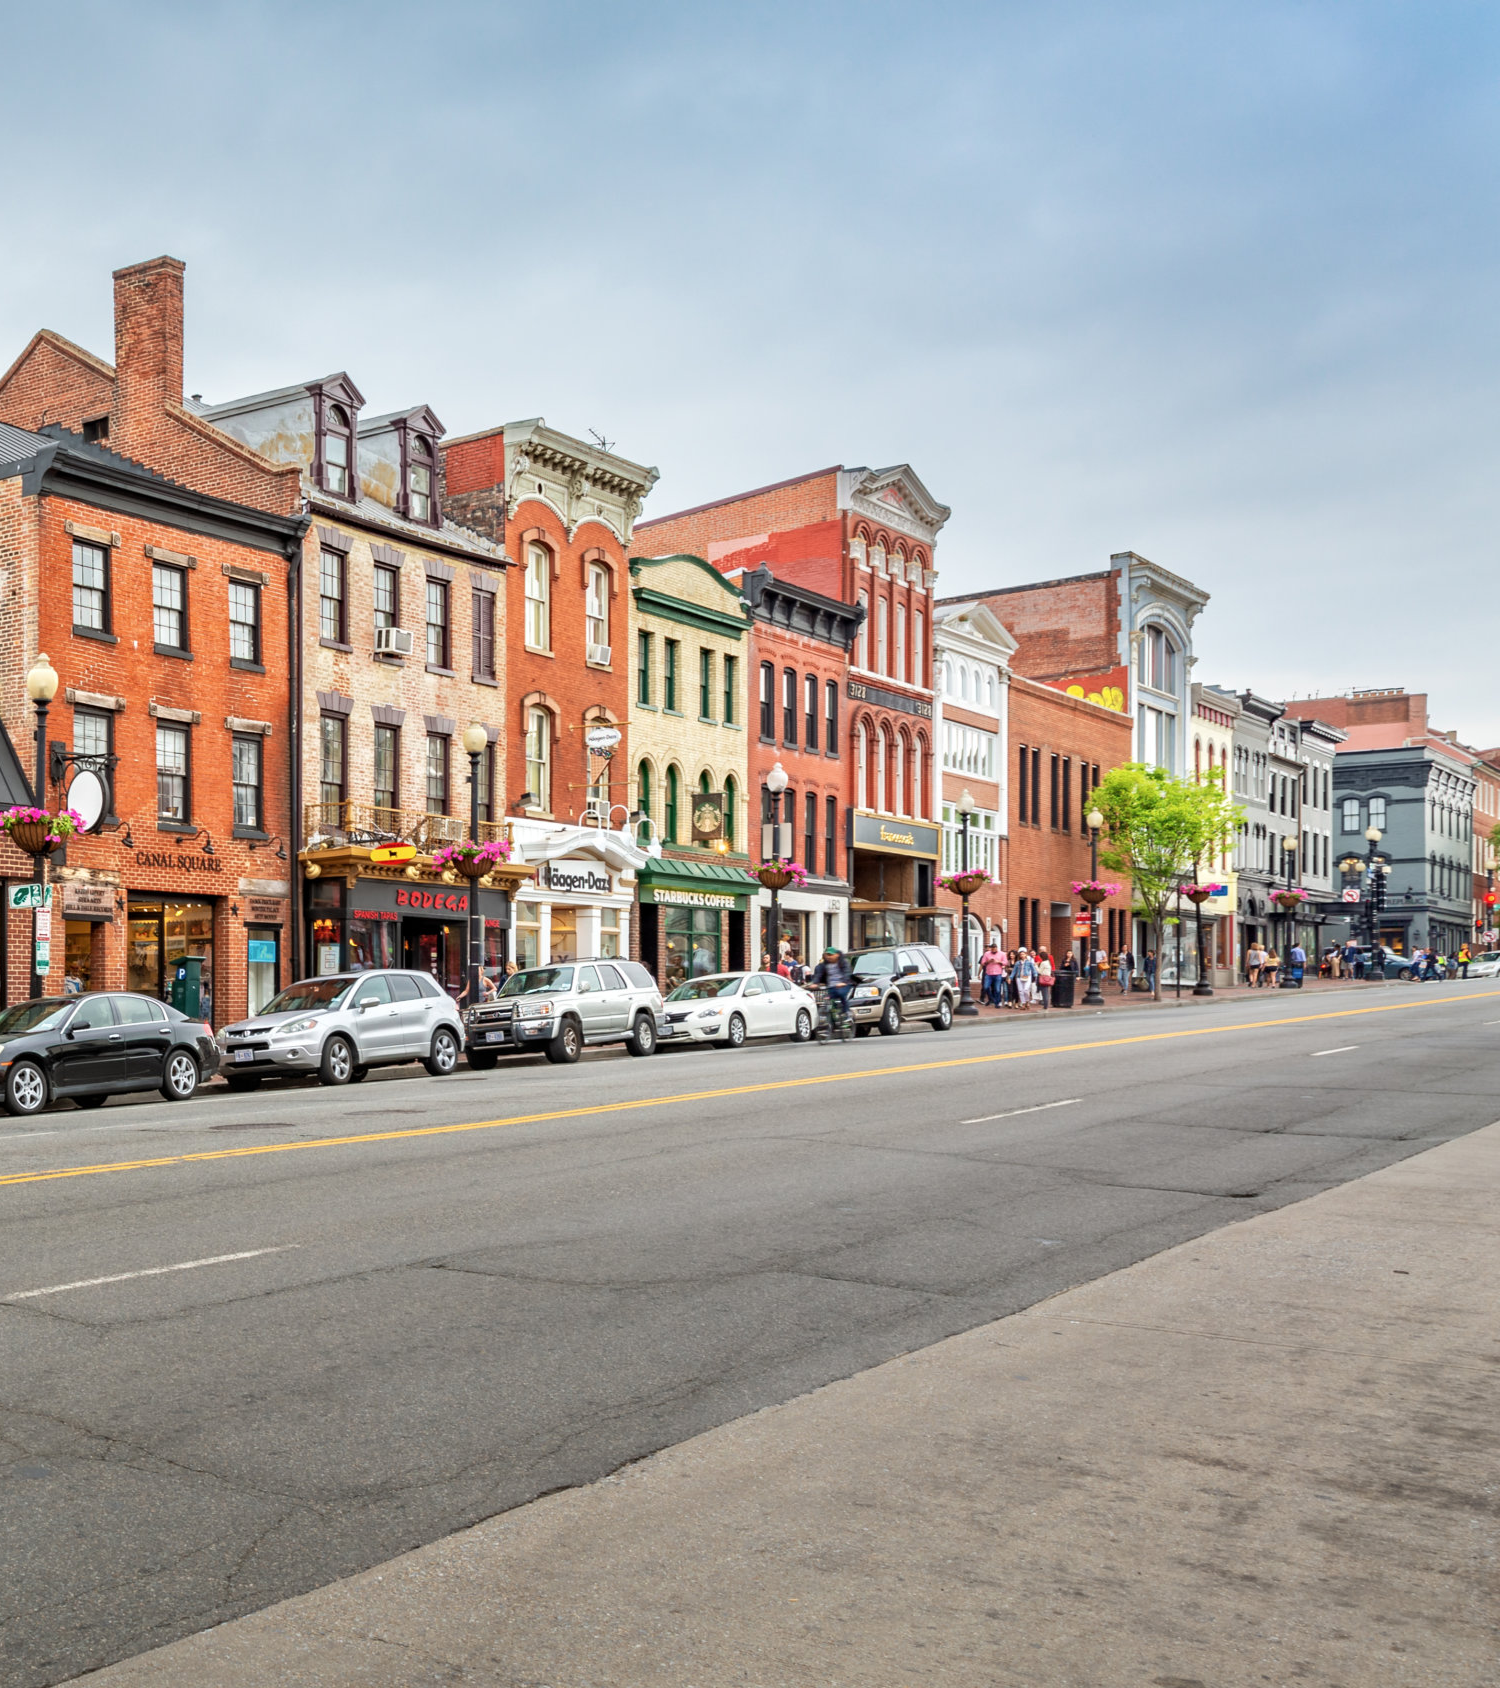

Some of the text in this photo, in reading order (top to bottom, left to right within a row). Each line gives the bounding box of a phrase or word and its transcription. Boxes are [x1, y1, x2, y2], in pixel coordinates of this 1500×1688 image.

[850, 684, 866, 698] 3128
[916, 702, 932, 716] 3128
[136, 851, 223, 872] CANAL SQUARE
[396, 889, 469, 912] BODEGA
[653, 889, 735, 908] STARBUCKS COFFEE
[353, 910, 398, 921] SPANISH TAPAS
[179, 968, 185, 980] P
